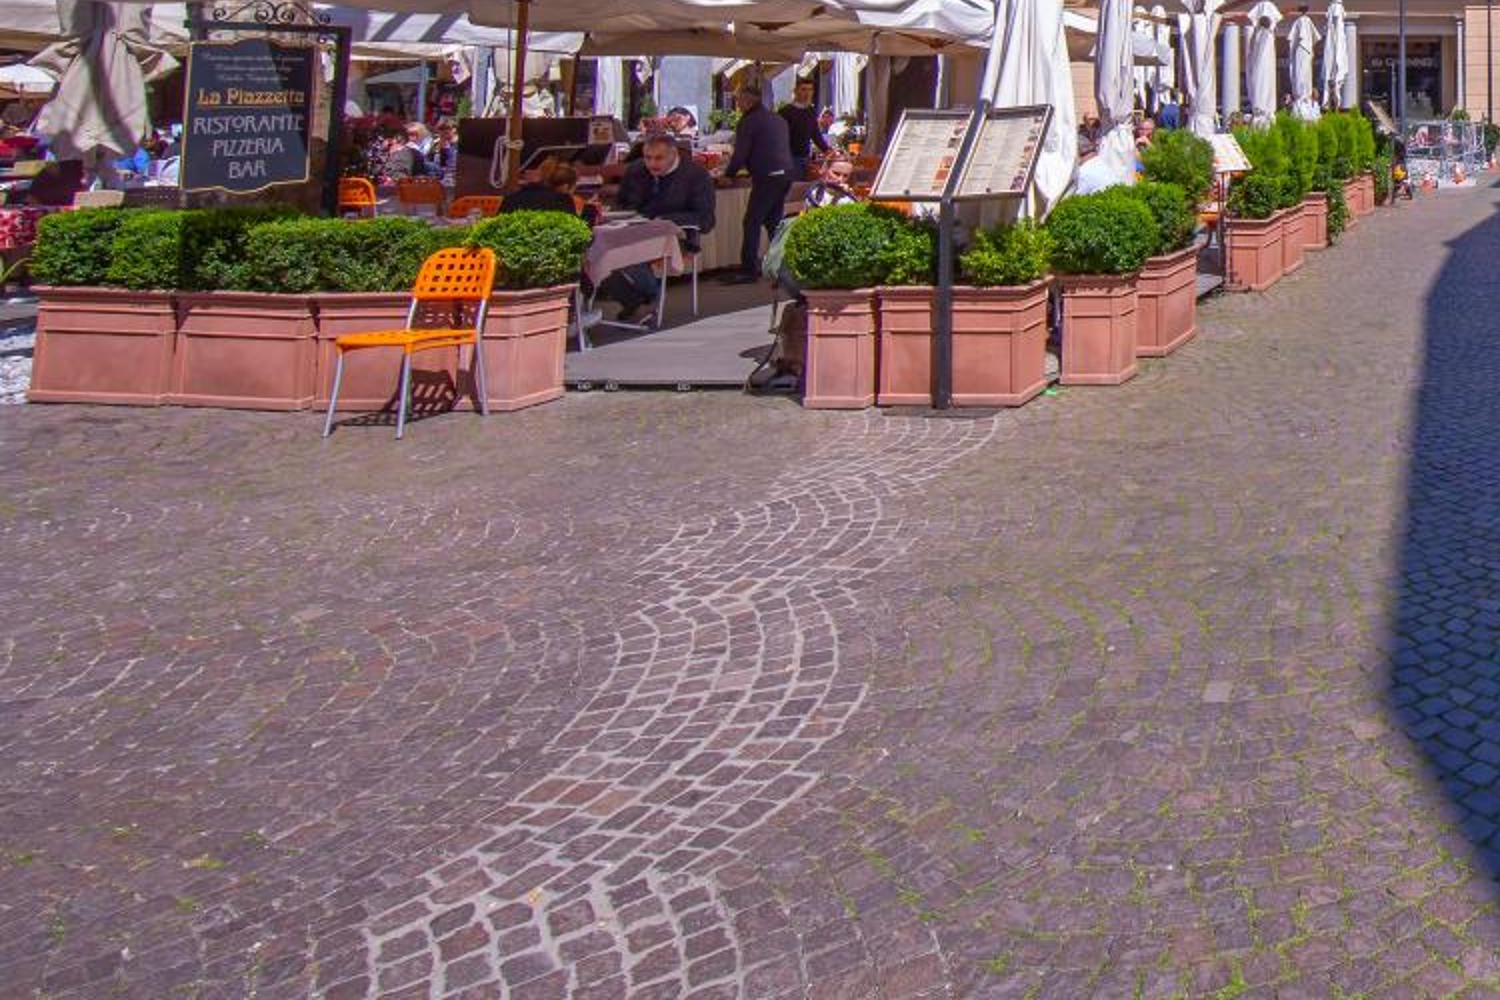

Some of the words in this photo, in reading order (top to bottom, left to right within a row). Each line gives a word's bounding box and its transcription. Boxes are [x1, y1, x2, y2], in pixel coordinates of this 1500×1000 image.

[199, 88, 220, 105] La
[227, 87, 305, 106] Piazzetta
[194, 116, 303, 135] RISTORANTE
[213, 139, 284, 157] PIZZERIA
[229, 161, 266, 179] BAR
